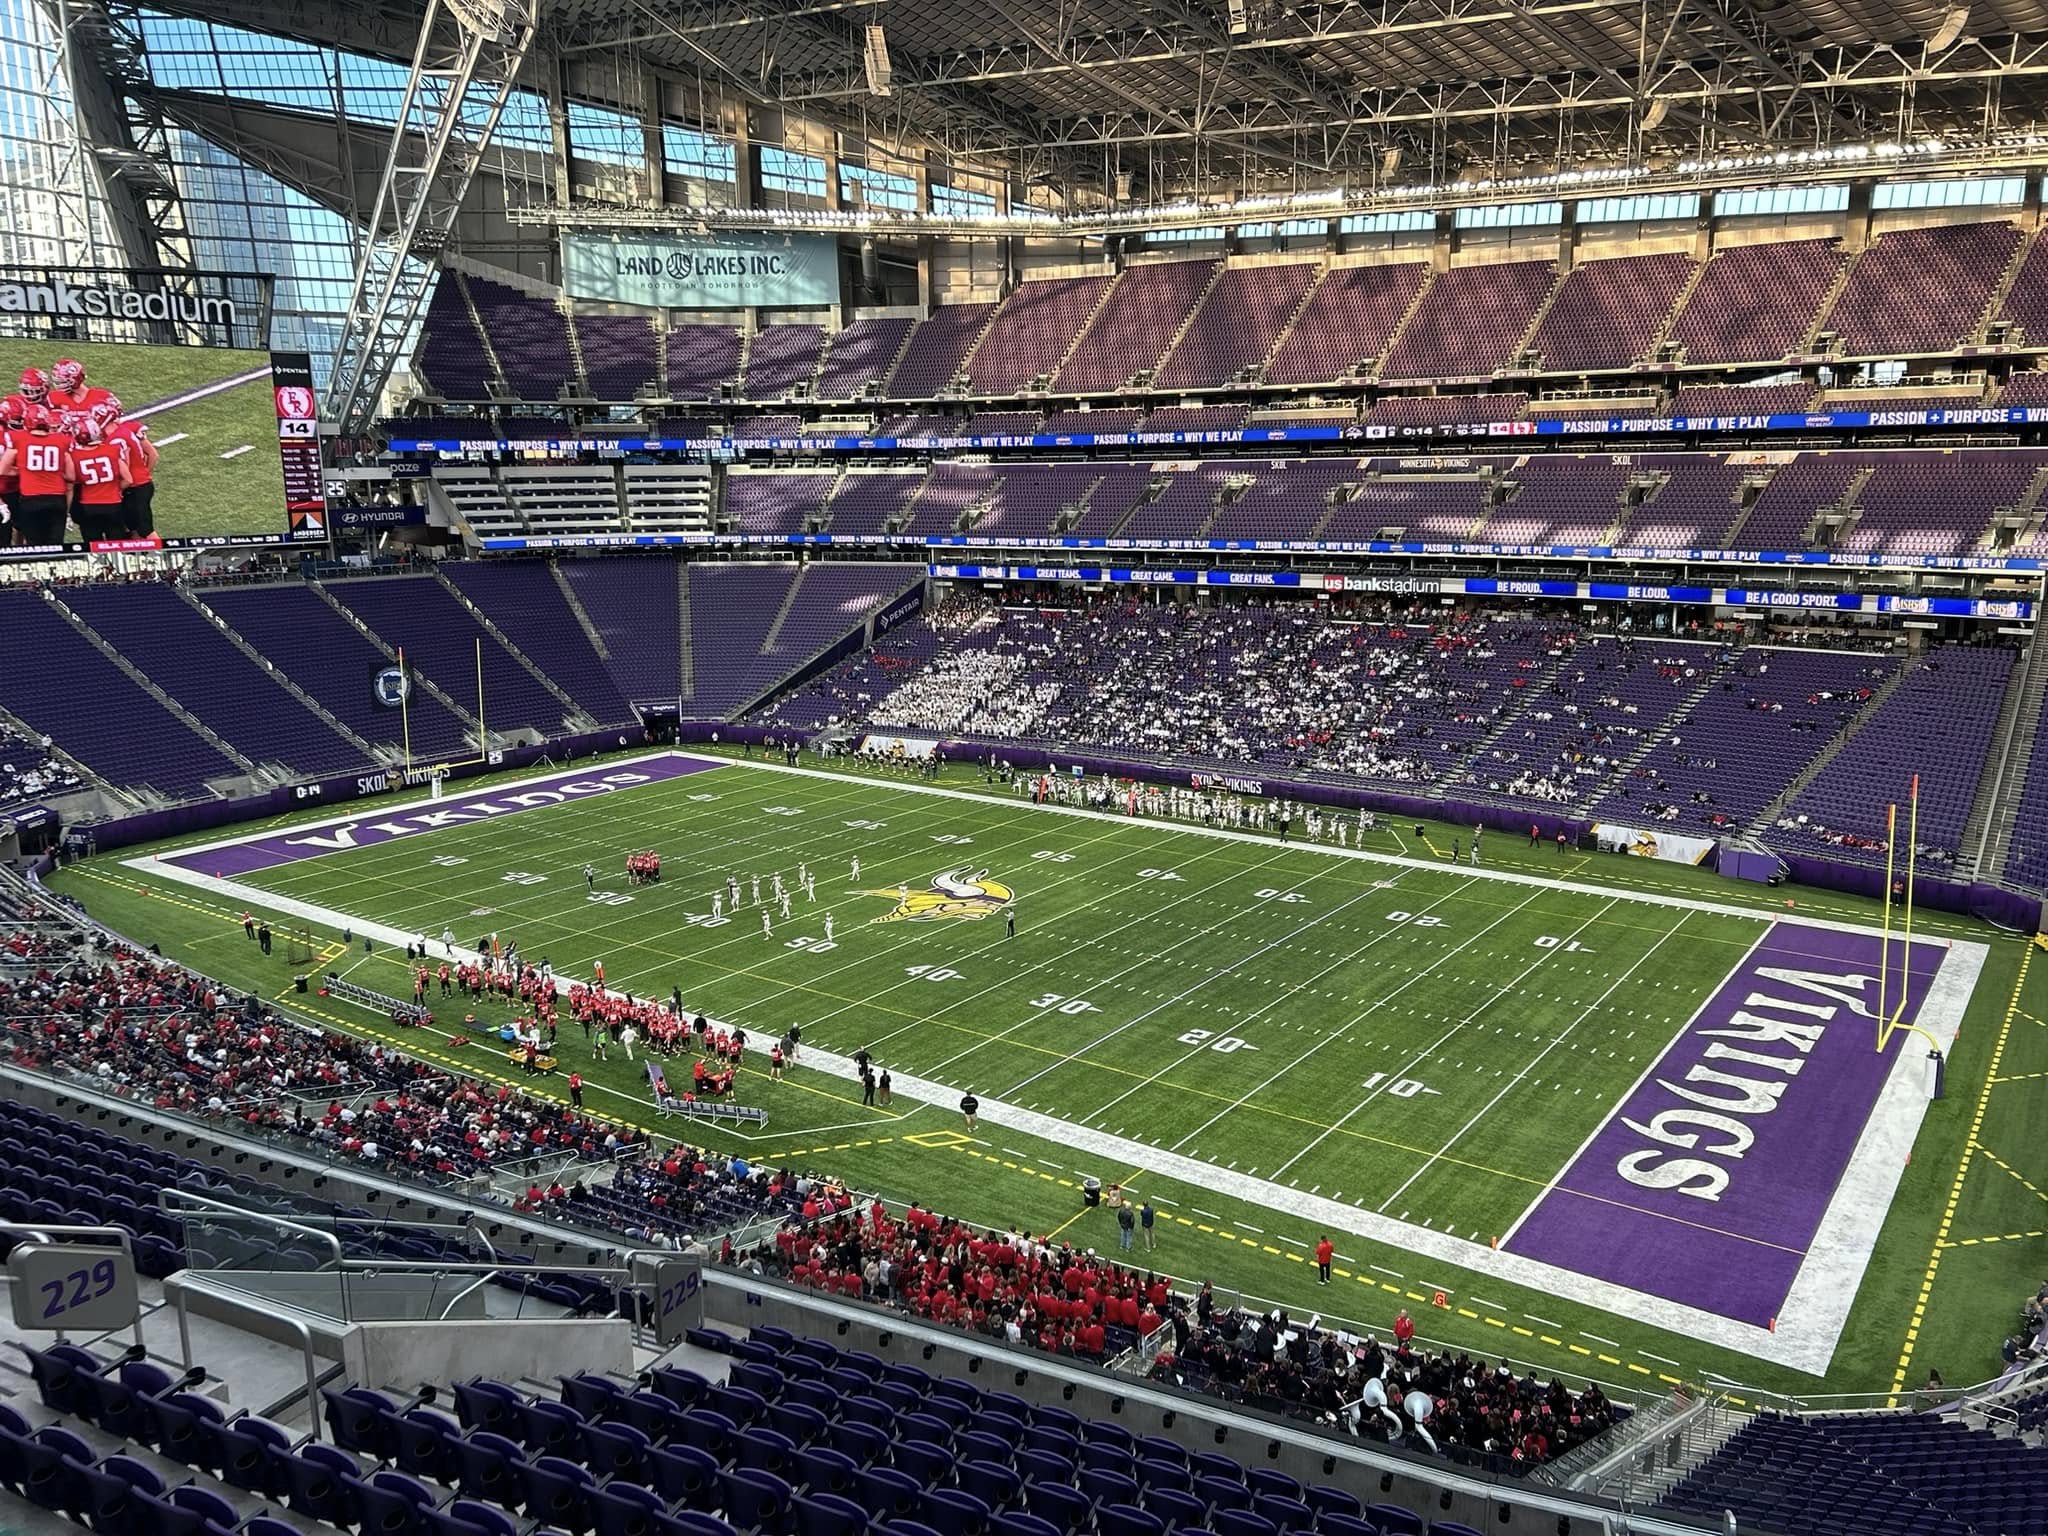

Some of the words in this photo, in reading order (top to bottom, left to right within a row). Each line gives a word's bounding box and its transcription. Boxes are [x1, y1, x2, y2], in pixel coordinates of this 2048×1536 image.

[616, 256, 663, 275] LAND
[695, 256, 747, 275] LAKES
[751, 255, 785, 275] INC.
[1869, 411, 1928, 425] PASSION
[1930, 414, 1940, 423] +
[1943, 409, 2009, 424] PURPOSE
[2012, 412, 2023, 420] =
[285, 422, 309, 434] 14
[1403, 427, 1433, 436] 0:14
[1563, 421, 1608, 433] PASSION
[1621, 420, 1673, 431] PURPOSE
[1687, 418, 1715, 430] WHY
[1717, 417, 1736, 429] WE
[1739, 416, 1770, 428] PLAY
[460, 441, 498, 450] PASSION
[508, 441, 549, 450] PURPOSE
[558, 440, 579, 450] WHY
[581, 440, 595, 450] WE
[597, 440, 619, 449] PLAY
[685, 440, 722, 449] PASSION
[731, 440, 770, 449] PURPOSE
[779, 440, 799, 448] WHY
[800, 440, 815, 449] WE
[816, 439, 836, 449] PLAY
[896, 439, 929, 448] PASSION
[938, 438, 973, 448] PURPOSE
[981, 438, 999, 447] WHY
[1000, 438, 1013, 446] WE
[1014, 437, 1034, 446] PLAY
[1094, 435, 1128, 445] PASSION
[1137, 434, 1175, 444] PURPOSE
[1184, 433, 1204, 443] WHY
[1206, 433, 1220, 442] WE
[1221, 431, 1243, 441] PLAY
[27, 444, 60, 472] 60
[1400, 459, 1435, 468] MINNESOTA
[1443, 458, 1471, 468] VIKINGS
[1612, 455, 1632, 465] SKOL
[79, 456, 114, 485] 53
[390, 463, 420, 472] paze
[1271, 461, 1287, 470] SKOL
[327, 482, 344, 496] 25
[361, 512, 405, 522] HYUNDAI
[122, 541, 155, 549] RIVER
[1423, 544, 1452, 552] PASSION
[1460, 545, 1493, 553] PURPOSE
[1501, 546, 1519, 554] WHY
[1520, 547, 1533, 555] WE
[1533, 547, 1553, 555] PLAY
[1611, 548, 1646, 557] PASSION
[1654, 549, 1692, 558] PURPOSE
[1701, 551, 1720, 559] WHY
[1722, 551, 1736, 560] WE
[1738, 552, 1760, 560] PLAY
[1829, 554, 1870, 564] PASSION
[1881, 556, 1926, 565] PURPOSE
[1937, 557, 1961, 567] WHY
[1963, 558, 1979, 568] WE
[1981, 558, 2009, 568] PLAY
[1036, 568, 1057, 578] GREAT
[1058, 568, 1081, 579] TEAMS.
[1131, 571, 1152, 581] GREAT
[1153, 572, 1175, 581] GAME.
[1230, 573, 1252, 583] GREAT
[1254, 574, 1275, 584] FANS.
[1497, 582, 1508, 592] BE
[1510, 582, 1543, 593] PROUD.
[1628, 587, 1641, 598] BE
[1642, 588, 1670, 599] LOUD.
[1746, 592, 1760, 603] BE
[1761, 593, 1770, 604] A
[1771, 594, 1800, 605] GOOD
[1802, 594, 1839, 607] SPORT.
[889, 598, 919, 622] PENTAIR
[489, 752, 502, 762] 25
[296, 784, 320, 798] 0:14
[357, 776, 389, 795] SKOL
[1225, 777, 1262, 794] VIKINGS
[285, 772, 651, 849] VIKINGS
[784, 936, 838, 953] 50
[905, 965, 957, 982] 40
[1029, 993, 1091, 1015] 30
[1177, 1028, 1247, 1053] 20
[1361, 1071, 1426, 1099] 10
[1616, 966, 1891, 1202] VIKINGS
[41, 1259, 116, 1319] 229
[662, 1271, 698, 1316] 229
[1435, 1294, 1446, 1305] G
